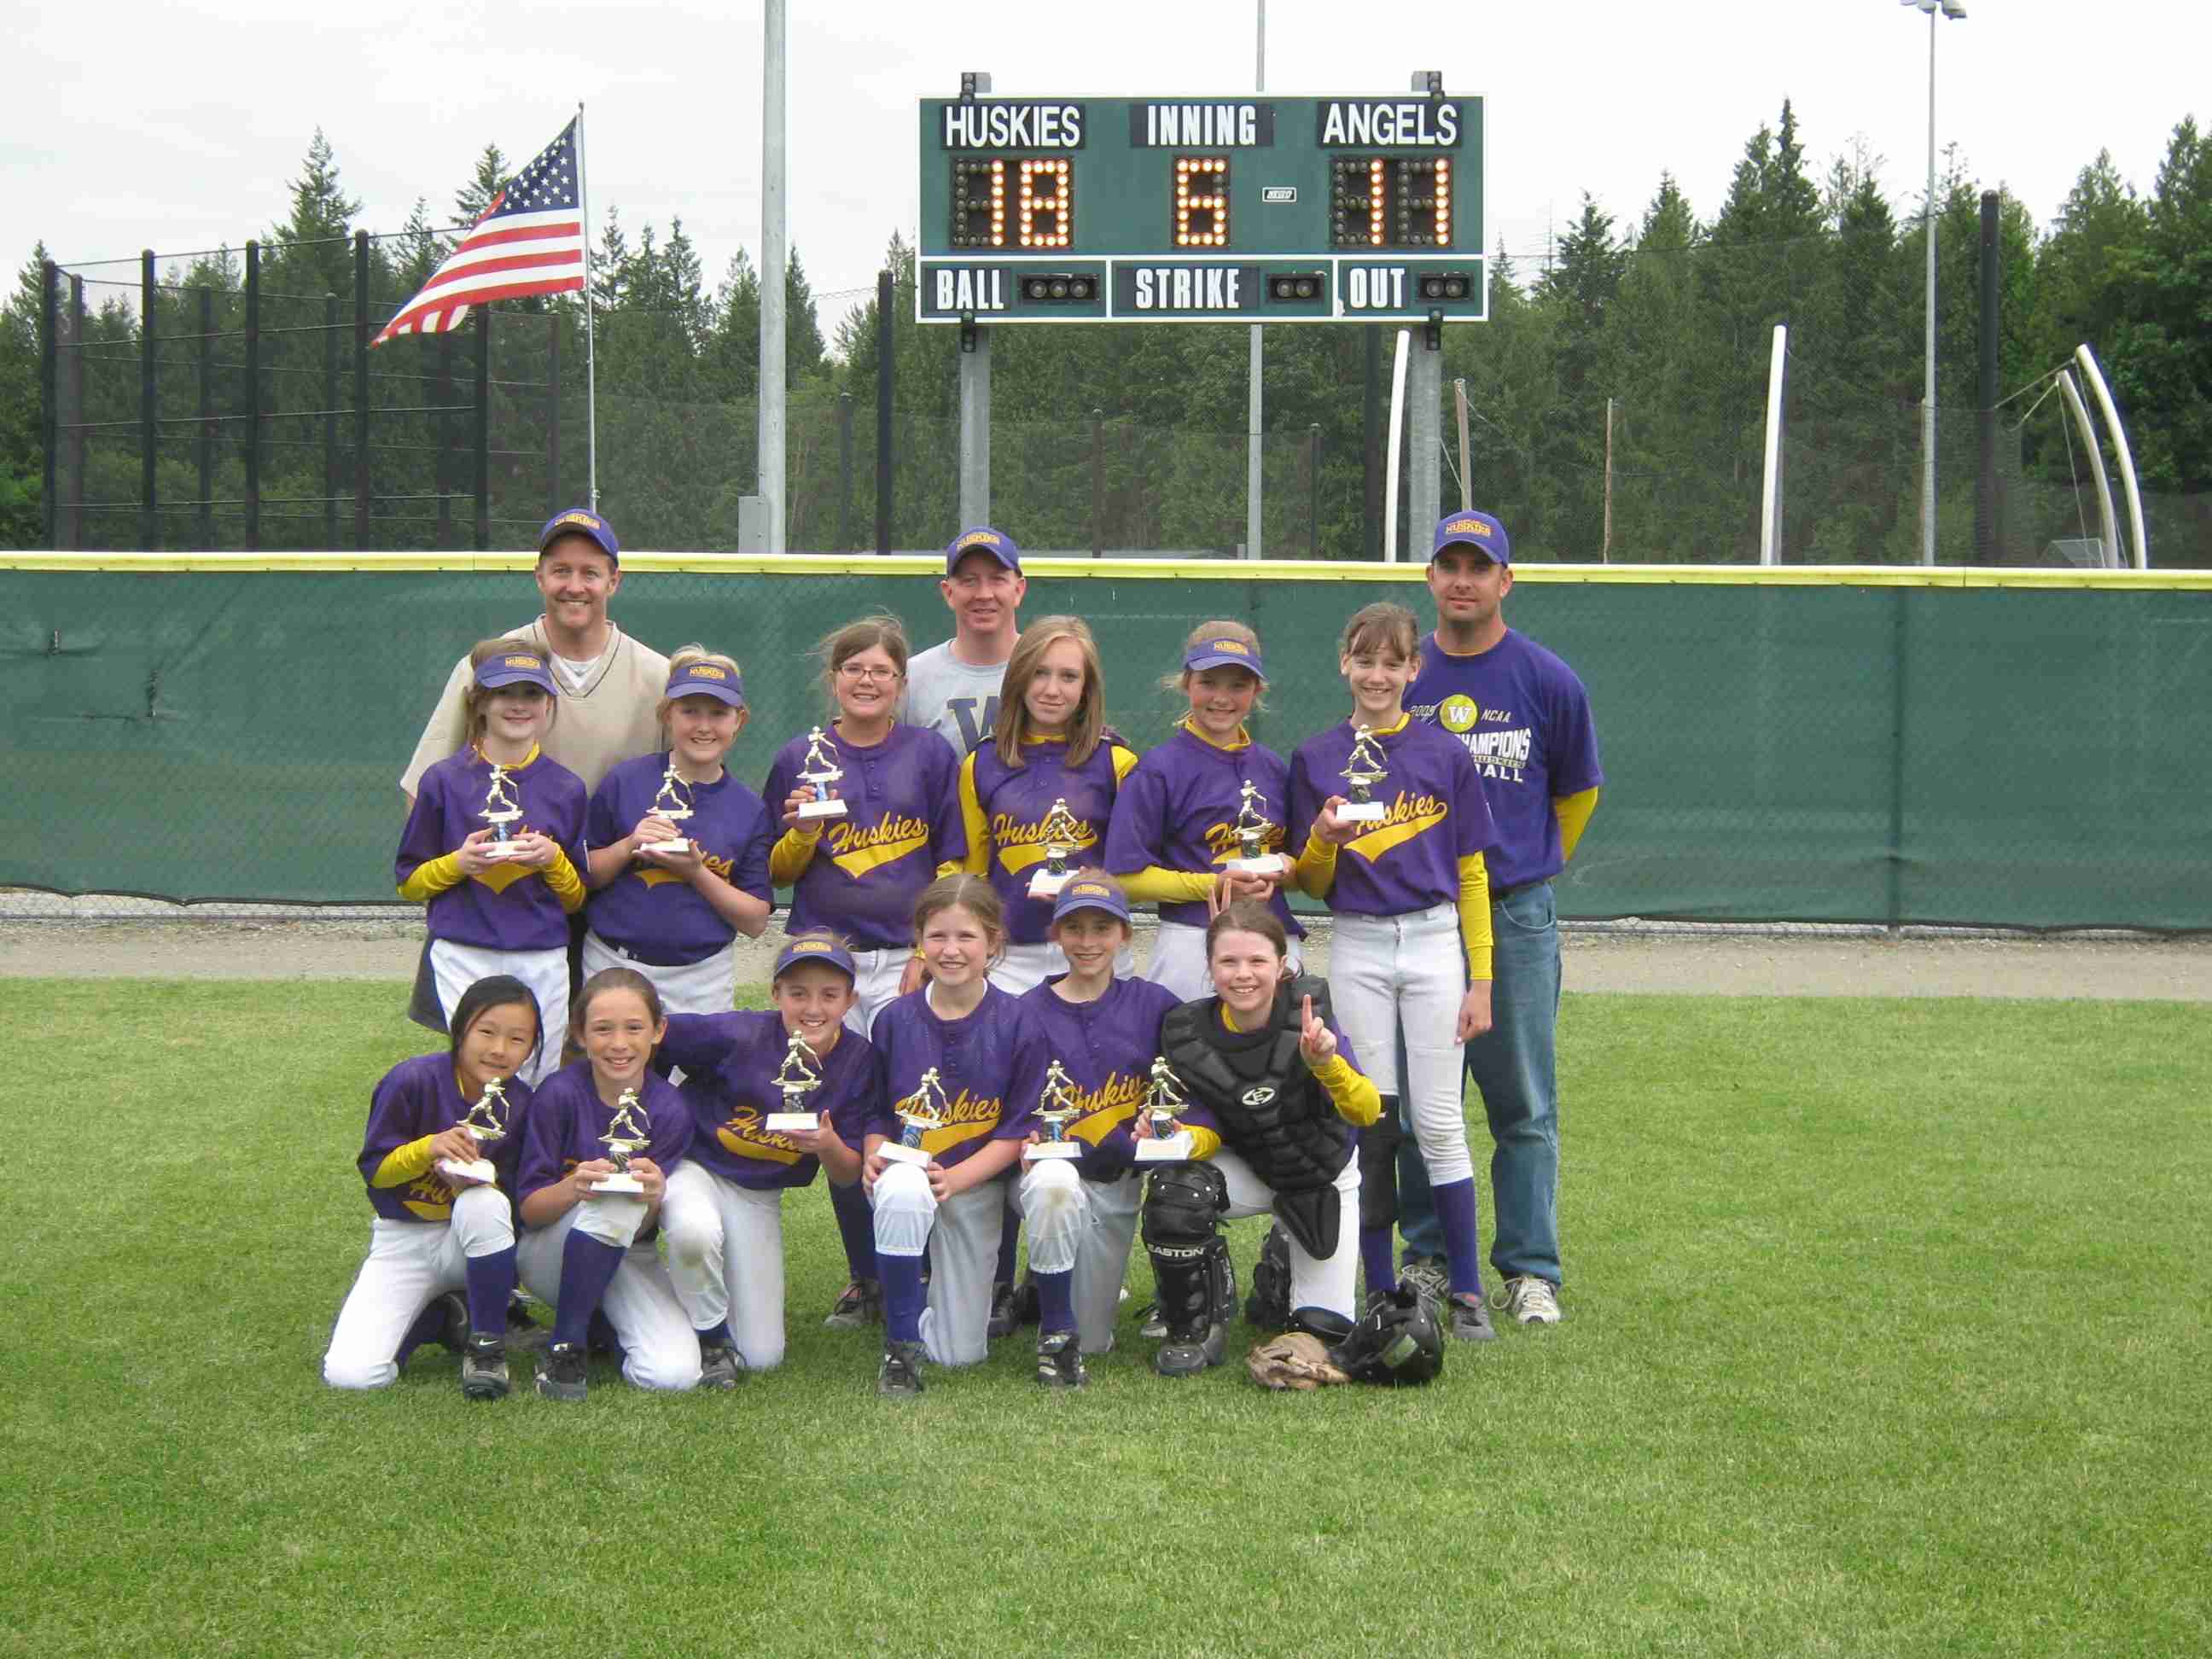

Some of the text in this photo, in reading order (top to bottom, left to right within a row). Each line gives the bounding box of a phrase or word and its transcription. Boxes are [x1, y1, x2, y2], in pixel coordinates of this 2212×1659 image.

[944, 104, 1081, 148] HUSKIES
[1147, 104, 1256, 146] INNING
[1322, 102, 1458, 146] ANGELS
[991, 158, 1070, 247] 18
[1174, 157, 1227, 247] 6
[935, 268, 1004, 311] BALL
[1135, 267, 1241, 309] STRIKE
[1348, 267, 1406, 308] OUT
[1447, 705, 1472, 725] W
[1481, 708, 1511, 724] NCAA
[1455, 727, 1532, 762] HAMPIONS
[828, 811, 925, 853] Huskies
[1147, 1243, 1205, 1258] EASTON
